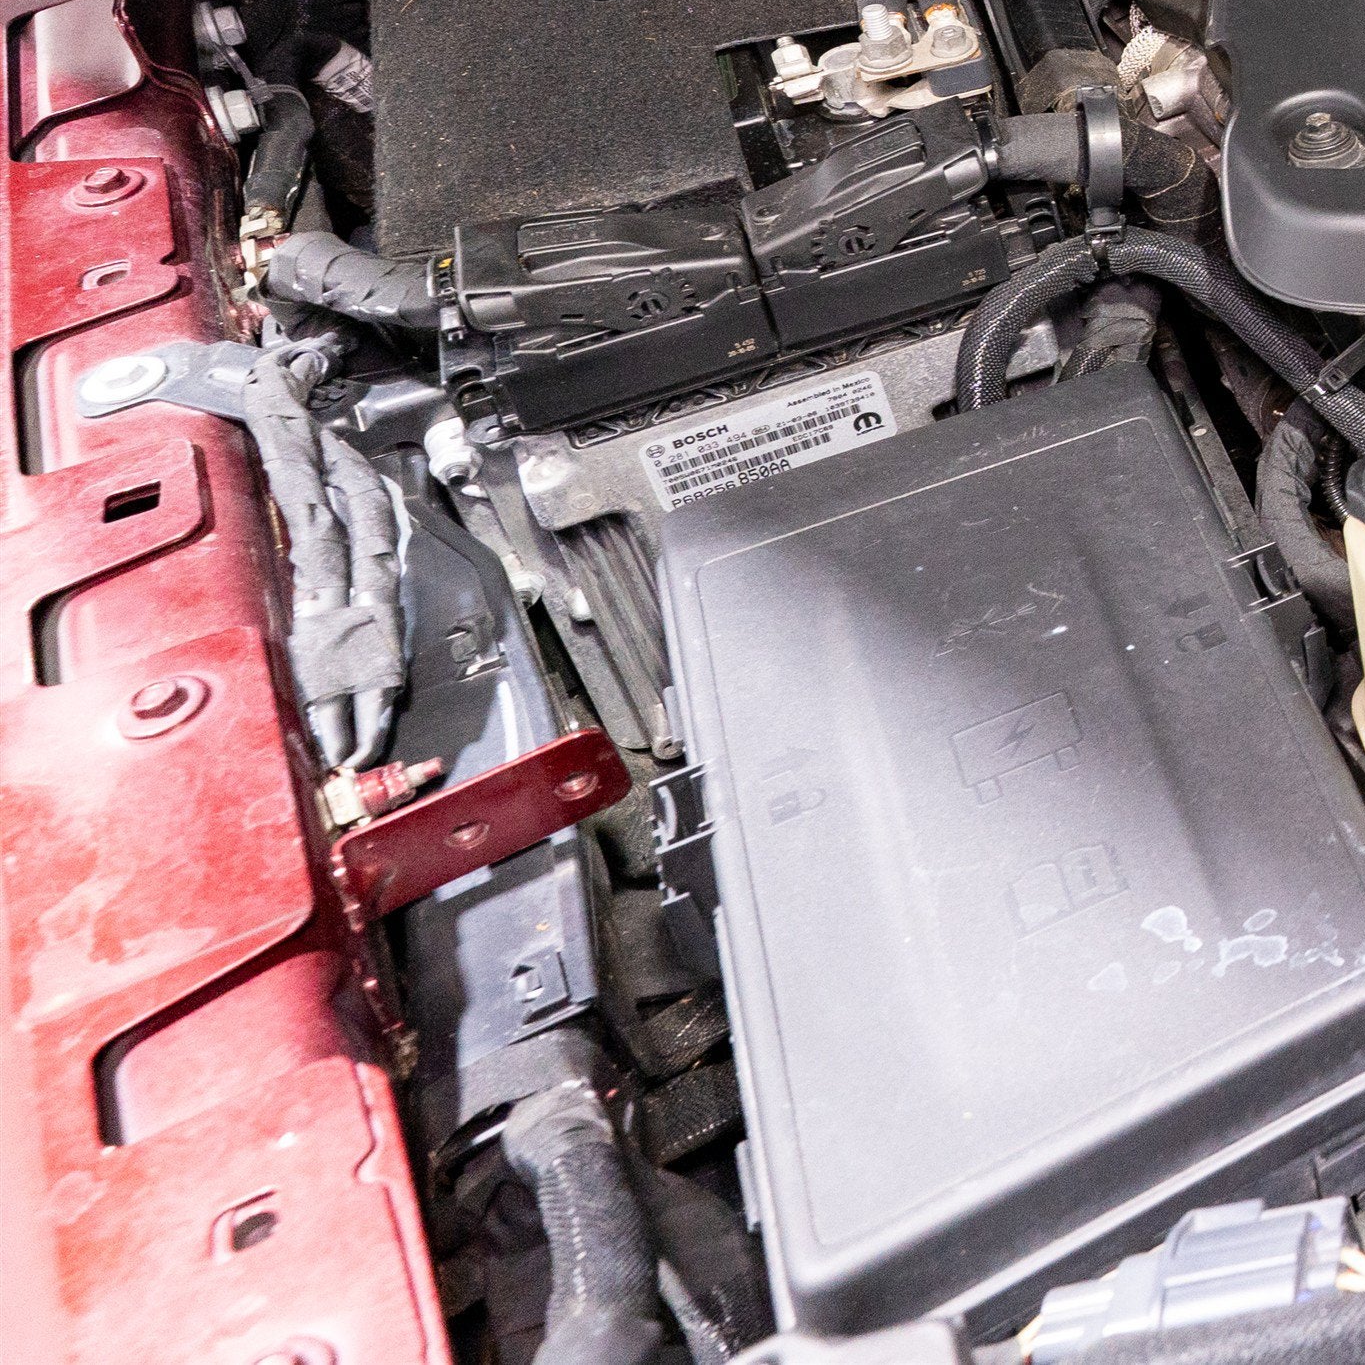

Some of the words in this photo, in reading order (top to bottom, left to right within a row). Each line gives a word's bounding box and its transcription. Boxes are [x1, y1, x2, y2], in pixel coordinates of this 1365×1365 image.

[786, 388, 830, 408] Assembled
[831, 385, 841, 394] in
[841, 376, 872, 390] Mexico
[668, 451, 690, 464] 281
[697, 443, 720, 457] 033
[726, 433, 747, 447] 494
[672, 423, 729, 450] BOSCH
[738, 458, 791, 486] 850AA
